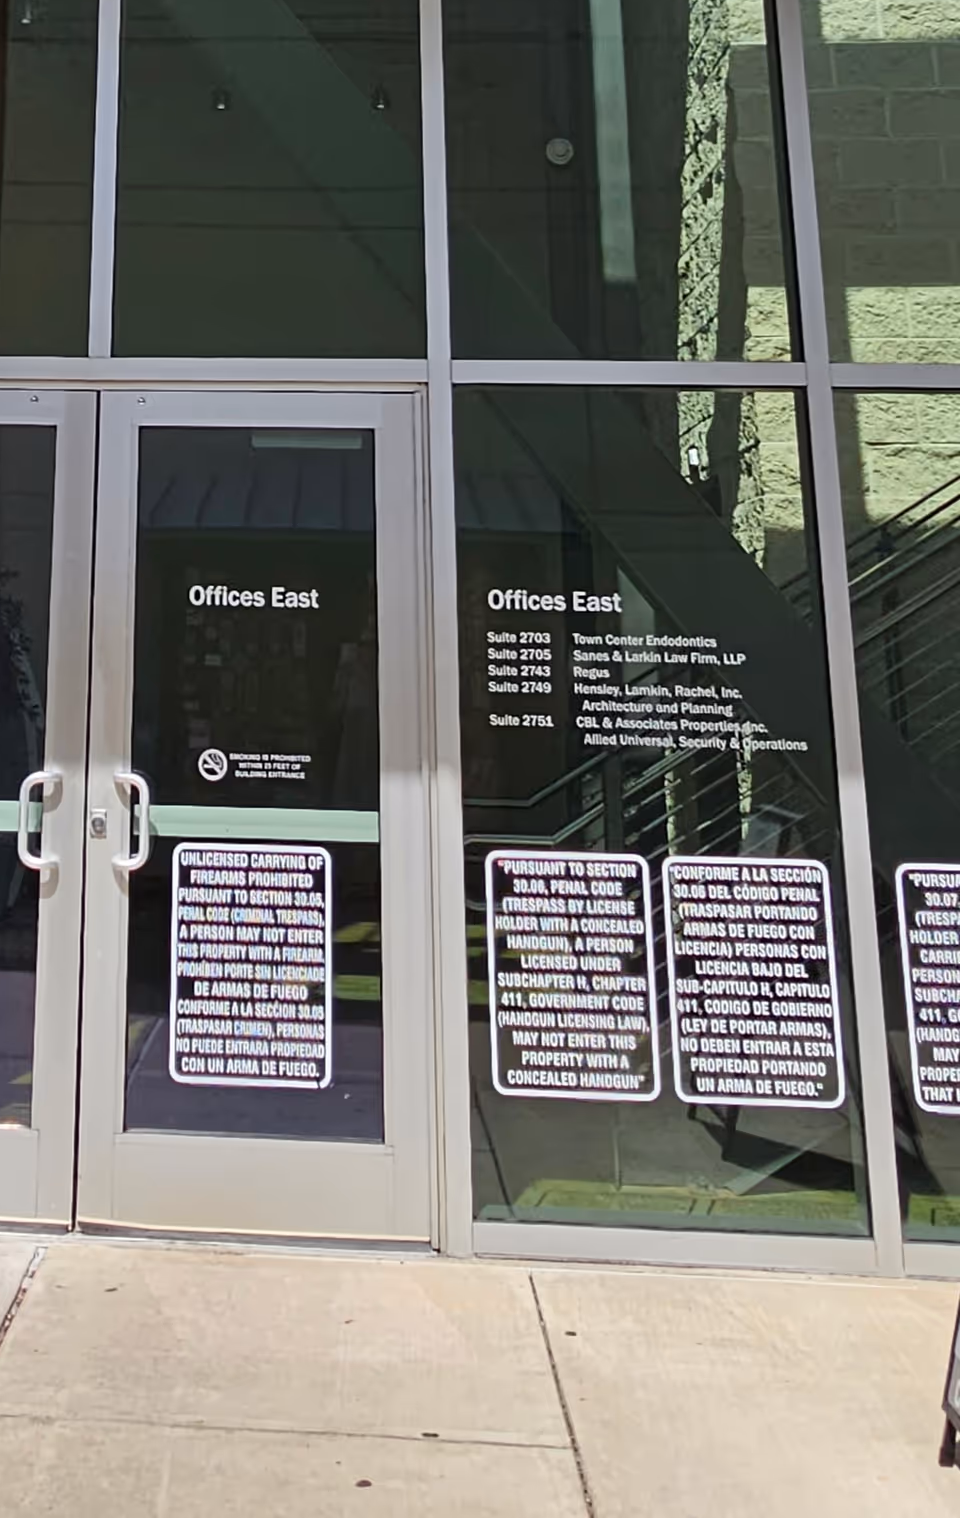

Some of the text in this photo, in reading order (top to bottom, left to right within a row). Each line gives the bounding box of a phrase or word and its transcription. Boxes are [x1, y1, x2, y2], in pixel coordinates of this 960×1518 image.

[188, 585, 319, 609] Offices East
[488, 589, 622, 613] Offices East
[487, 632, 717, 648] Suite 2703 Town Center Endodontics
[488, 649, 746, 665] Suite 2705 Sanes & Larkin Law Firm, LLP
[488, 665, 609, 680] Suite 2743 Regus
[488, 682, 518, 693] Suite
[521, 682, 552, 694] 2749
[574, 684, 622, 698] Hensley,
[675, 686, 718, 699] Rachel,
[721, 687, 742, 698] Inc.
[582, 700, 733, 716] Architecture and Planning
[489, 715, 519, 726] Suite
[522, 715, 553, 727] 2751
[576, 717, 599, 728] CBL
[603, 717, 612, 729] &
[615, 718, 677, 730] Associates
[584, 734, 616, 746] Allied
[678, 736, 726, 751] Security
[729, 738, 739, 749] &
[742, 739, 808, 752] Operations
[180, 851, 322, 870] UNLICENSED CARRYING OF
[568, 861, 584, 876] TO
[586, 862, 636, 878] SECTION
[190, 870, 312, 888] FIREARMS PROHIBITED
[741, 867, 750, 881] A
[752, 867, 767, 882] LA
[769, 866, 821, 884] SECCIÓN
[550, 879, 588, 895] PENAL
[590, 881, 622, 896] CODE
[708, 885, 730, 900] DEL
[733, 884, 778, 901] CÓDIGO
[781, 887, 819, 902] PENAL
[502, 897, 635, 915] (TRESPASS BY LICENSE
[678, 903, 817, 921] (TRASPASAR PORTANDO
[495, 915, 643, 935] HOLDER WITH A CONCEALED
[683, 922, 814, 940] ARMAS DE FUEGO CON
[179, 925, 322, 944] A PERSON MAY NOT ENTER
[909, 930, 959, 945] HOLDER
[575, 937, 584, 952] A
[586, 937, 633, 953] PERSON
[674, 940, 826, 960] LICENCIA) PERSONAS CON
[520, 954, 621, 972] LICENSED UNDER
[695, 960, 808, 978] LICENCIA BAJO DEL
[194, 981, 307, 999] DE ARMAS DE FUEGO
[497, 972, 574, 989] SUBCHAPTER
[591, 976, 645, 992] CHAPTER
[760, 982, 773, 998] H,
[501, 991, 644, 1011] 411, GOVERNMENT CODE
[676, 998, 832, 1018] 411, CODIGO DE GOBIERNO
[497, 1010, 556, 1029] (HANDGUN
[557, 1013, 615, 1029] LICENSING
[681, 1017, 708, 1034] (LEY
[710, 1018, 727, 1033] DE
[729, 1019, 777, 1035] PORTAR
[512, 1030, 636, 1050] MAY NOT ENTER THIS
[680, 1036, 834, 1057] NO DEBEN ENTRAR A ESTA
[521, 1050, 629, 1069] PROPERTY WITH A
[933, 1047, 959, 1062] MAY
[181, 1057, 319, 1076] CON UN ARMA DE FUEGO.
[690, 1056, 826, 1076] PROPIEDAD PORTANDO
[507, 1069, 576, 1086] CONCEALED
[696, 1075, 714, 1091] UN
[716, 1076, 753, 1092] ARMA
[755, 1078, 772, 1093] DE
[922, 1087, 953, 1101] THAT
